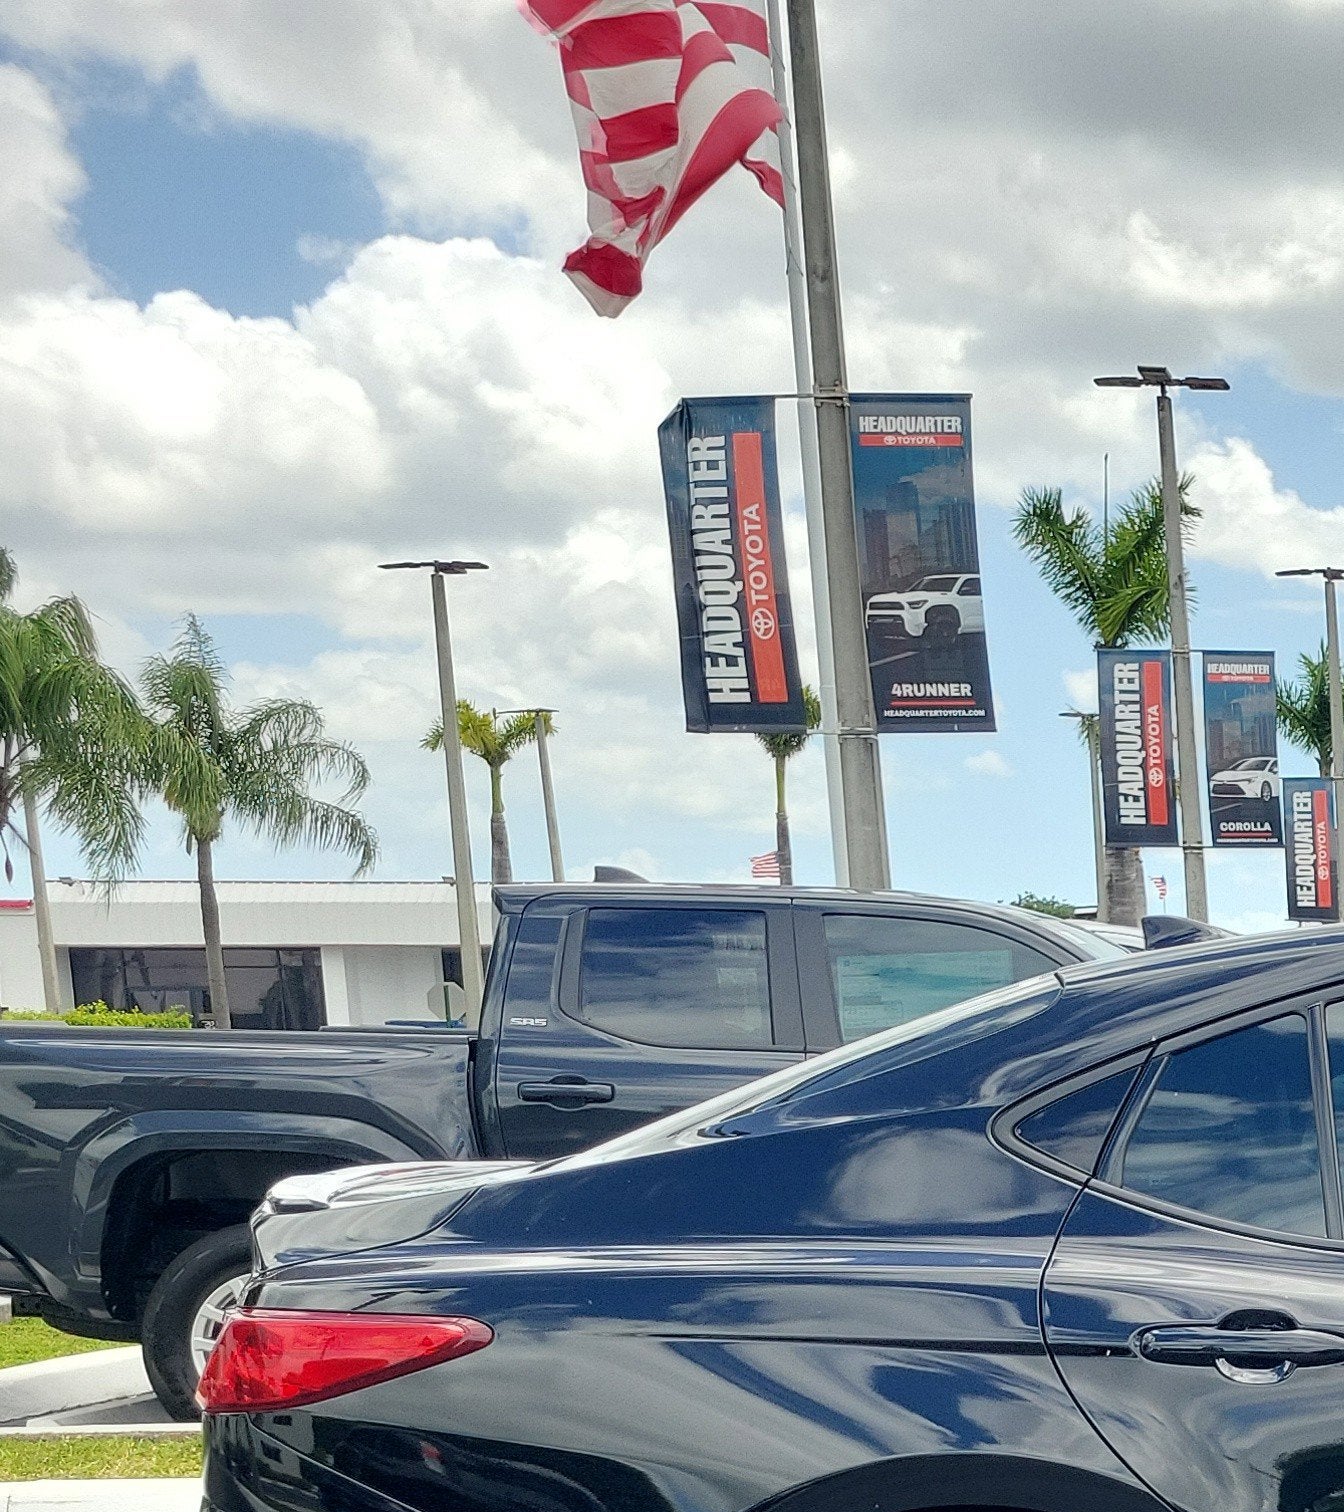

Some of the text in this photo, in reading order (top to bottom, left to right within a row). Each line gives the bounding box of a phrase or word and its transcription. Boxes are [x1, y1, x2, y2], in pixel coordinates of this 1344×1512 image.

[859, 415, 962, 434] HEADQUARTER
[897, 435, 936, 446] TOYOTA
[688, 435, 752, 704] HEADQUARTER
[742, 502, 770, 605] TOYOTA
[1207, 662, 1270, 675] HEADQUARTER
[891, 682, 972, 698] 4RUNNER
[884, 708, 985, 718] HEADQUARTERTOYOTA.COM
[1113, 662, 1147, 825] HEADQUARTER
[1147, 704, 1163, 767] TOYOTA
[1219, 821, 1272, 832] COROLLA
[1292, 790, 1317, 908] HEADQUARTER
[1316, 821, 1330, 866] TOYOTA
